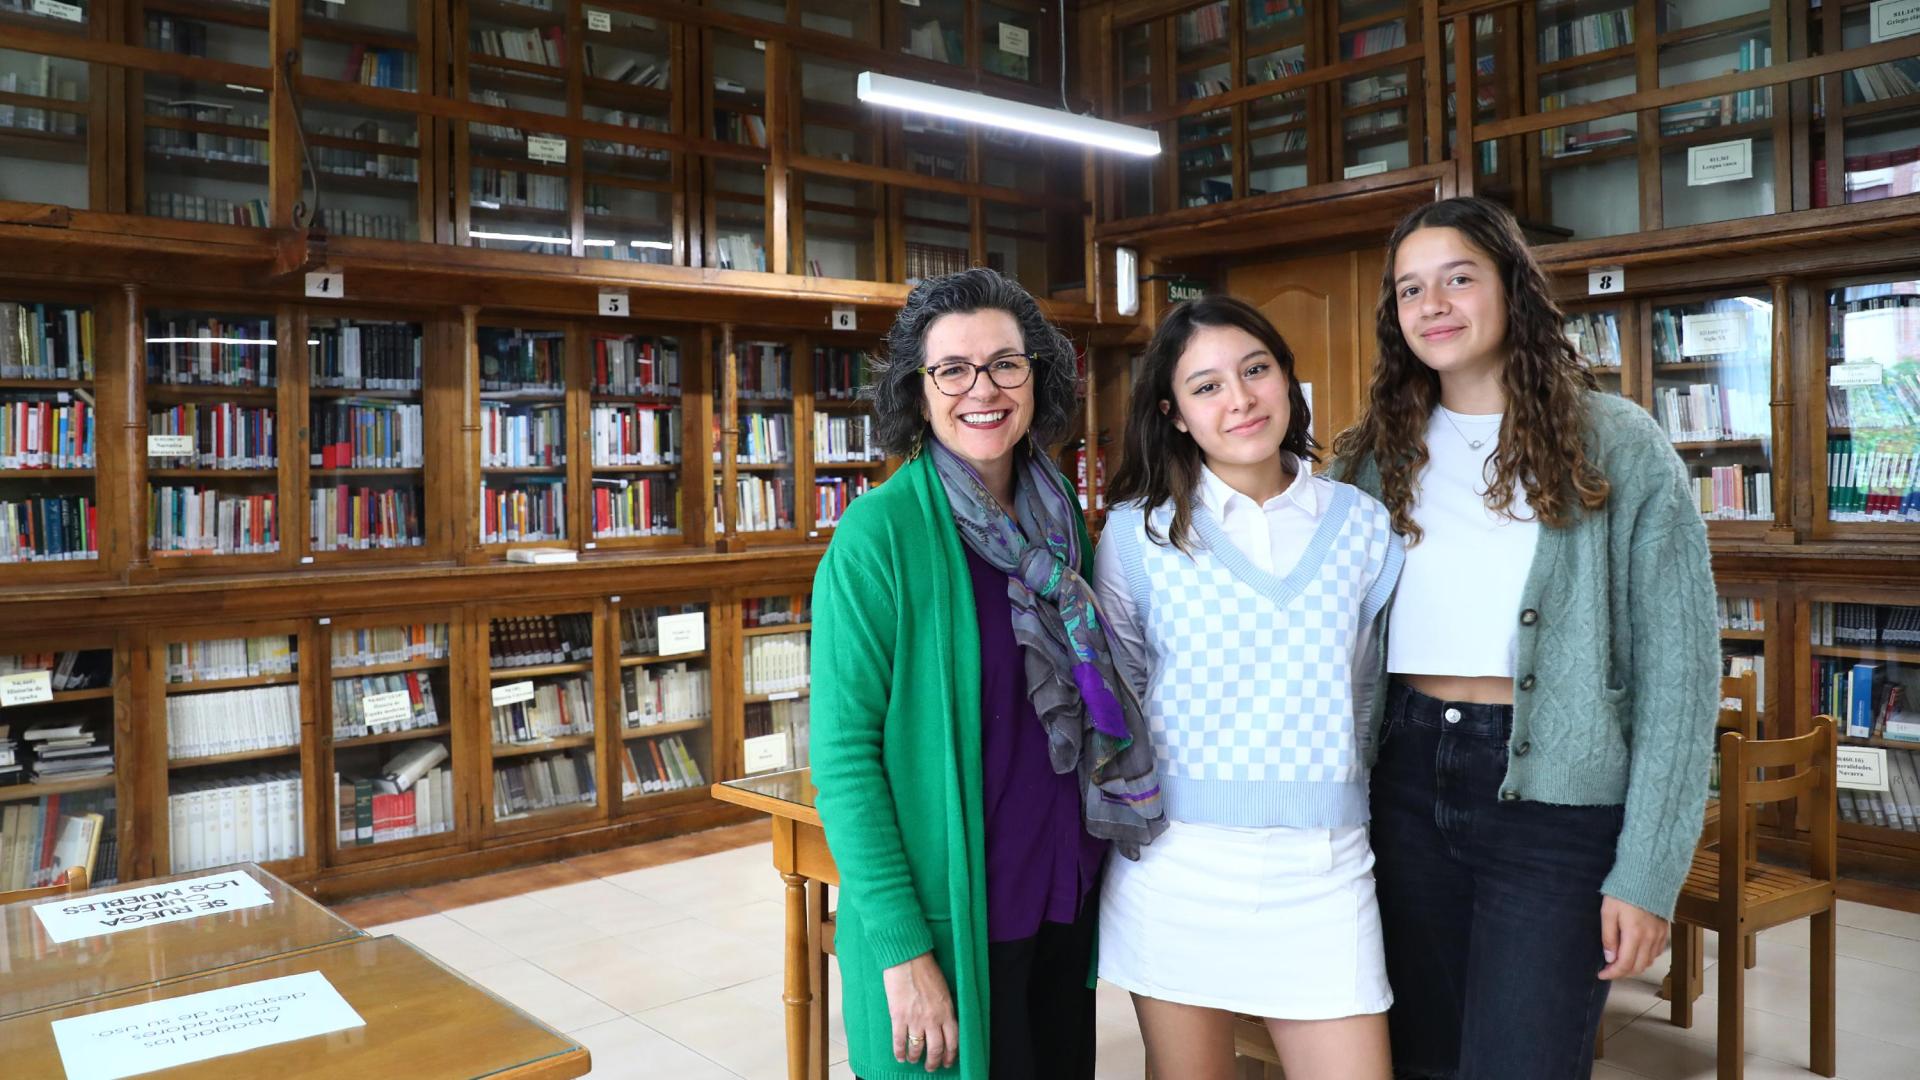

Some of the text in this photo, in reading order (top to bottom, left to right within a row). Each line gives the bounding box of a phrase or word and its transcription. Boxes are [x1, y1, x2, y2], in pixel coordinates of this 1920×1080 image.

[316, 277, 330, 292] 4
[1600, 275, 1612, 290] 8
[609, 298, 619, 312] 5
[840, 314, 848, 326] 6
[63, 880, 240, 914] LOS MUEBLES
[107, 894, 209, 916] CUIDAR
[99, 900, 228, 926] SE RUEGA
[92, 992, 306, 1037] después de su uso.
[132, 1006, 280, 1040] ordenadores
[144, 1015, 279, 1048] Apagad los
